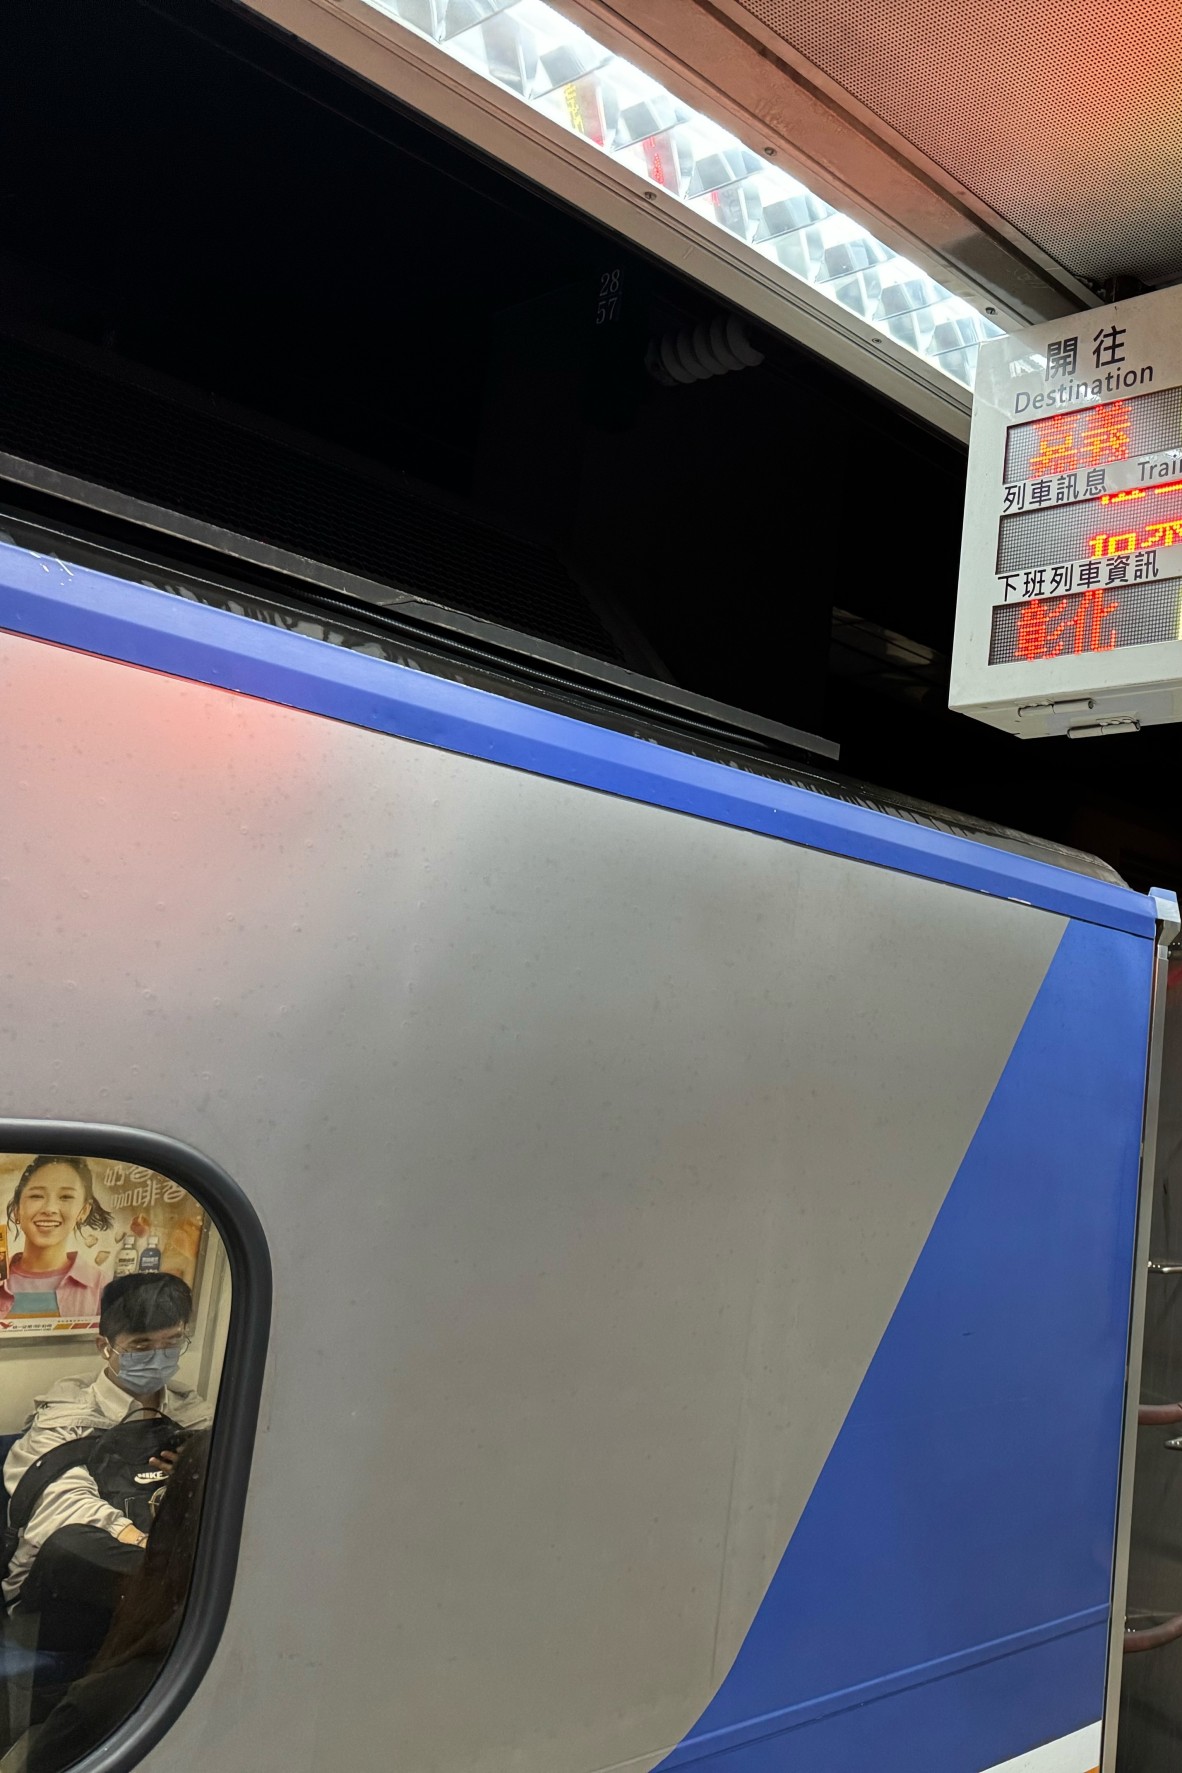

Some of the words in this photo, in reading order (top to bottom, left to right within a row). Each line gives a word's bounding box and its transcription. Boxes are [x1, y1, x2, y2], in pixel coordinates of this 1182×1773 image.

[600, 269, 620, 296] 28
[1045, 325, 1126, 381] 開往
[1014, 365, 1154, 414] Destination
[1003, 468, 1107, 513] 列車訊息
[998, 550, 1159, 602] 下班列車資訊
[1014, 589, 1119, 662] 彰化
